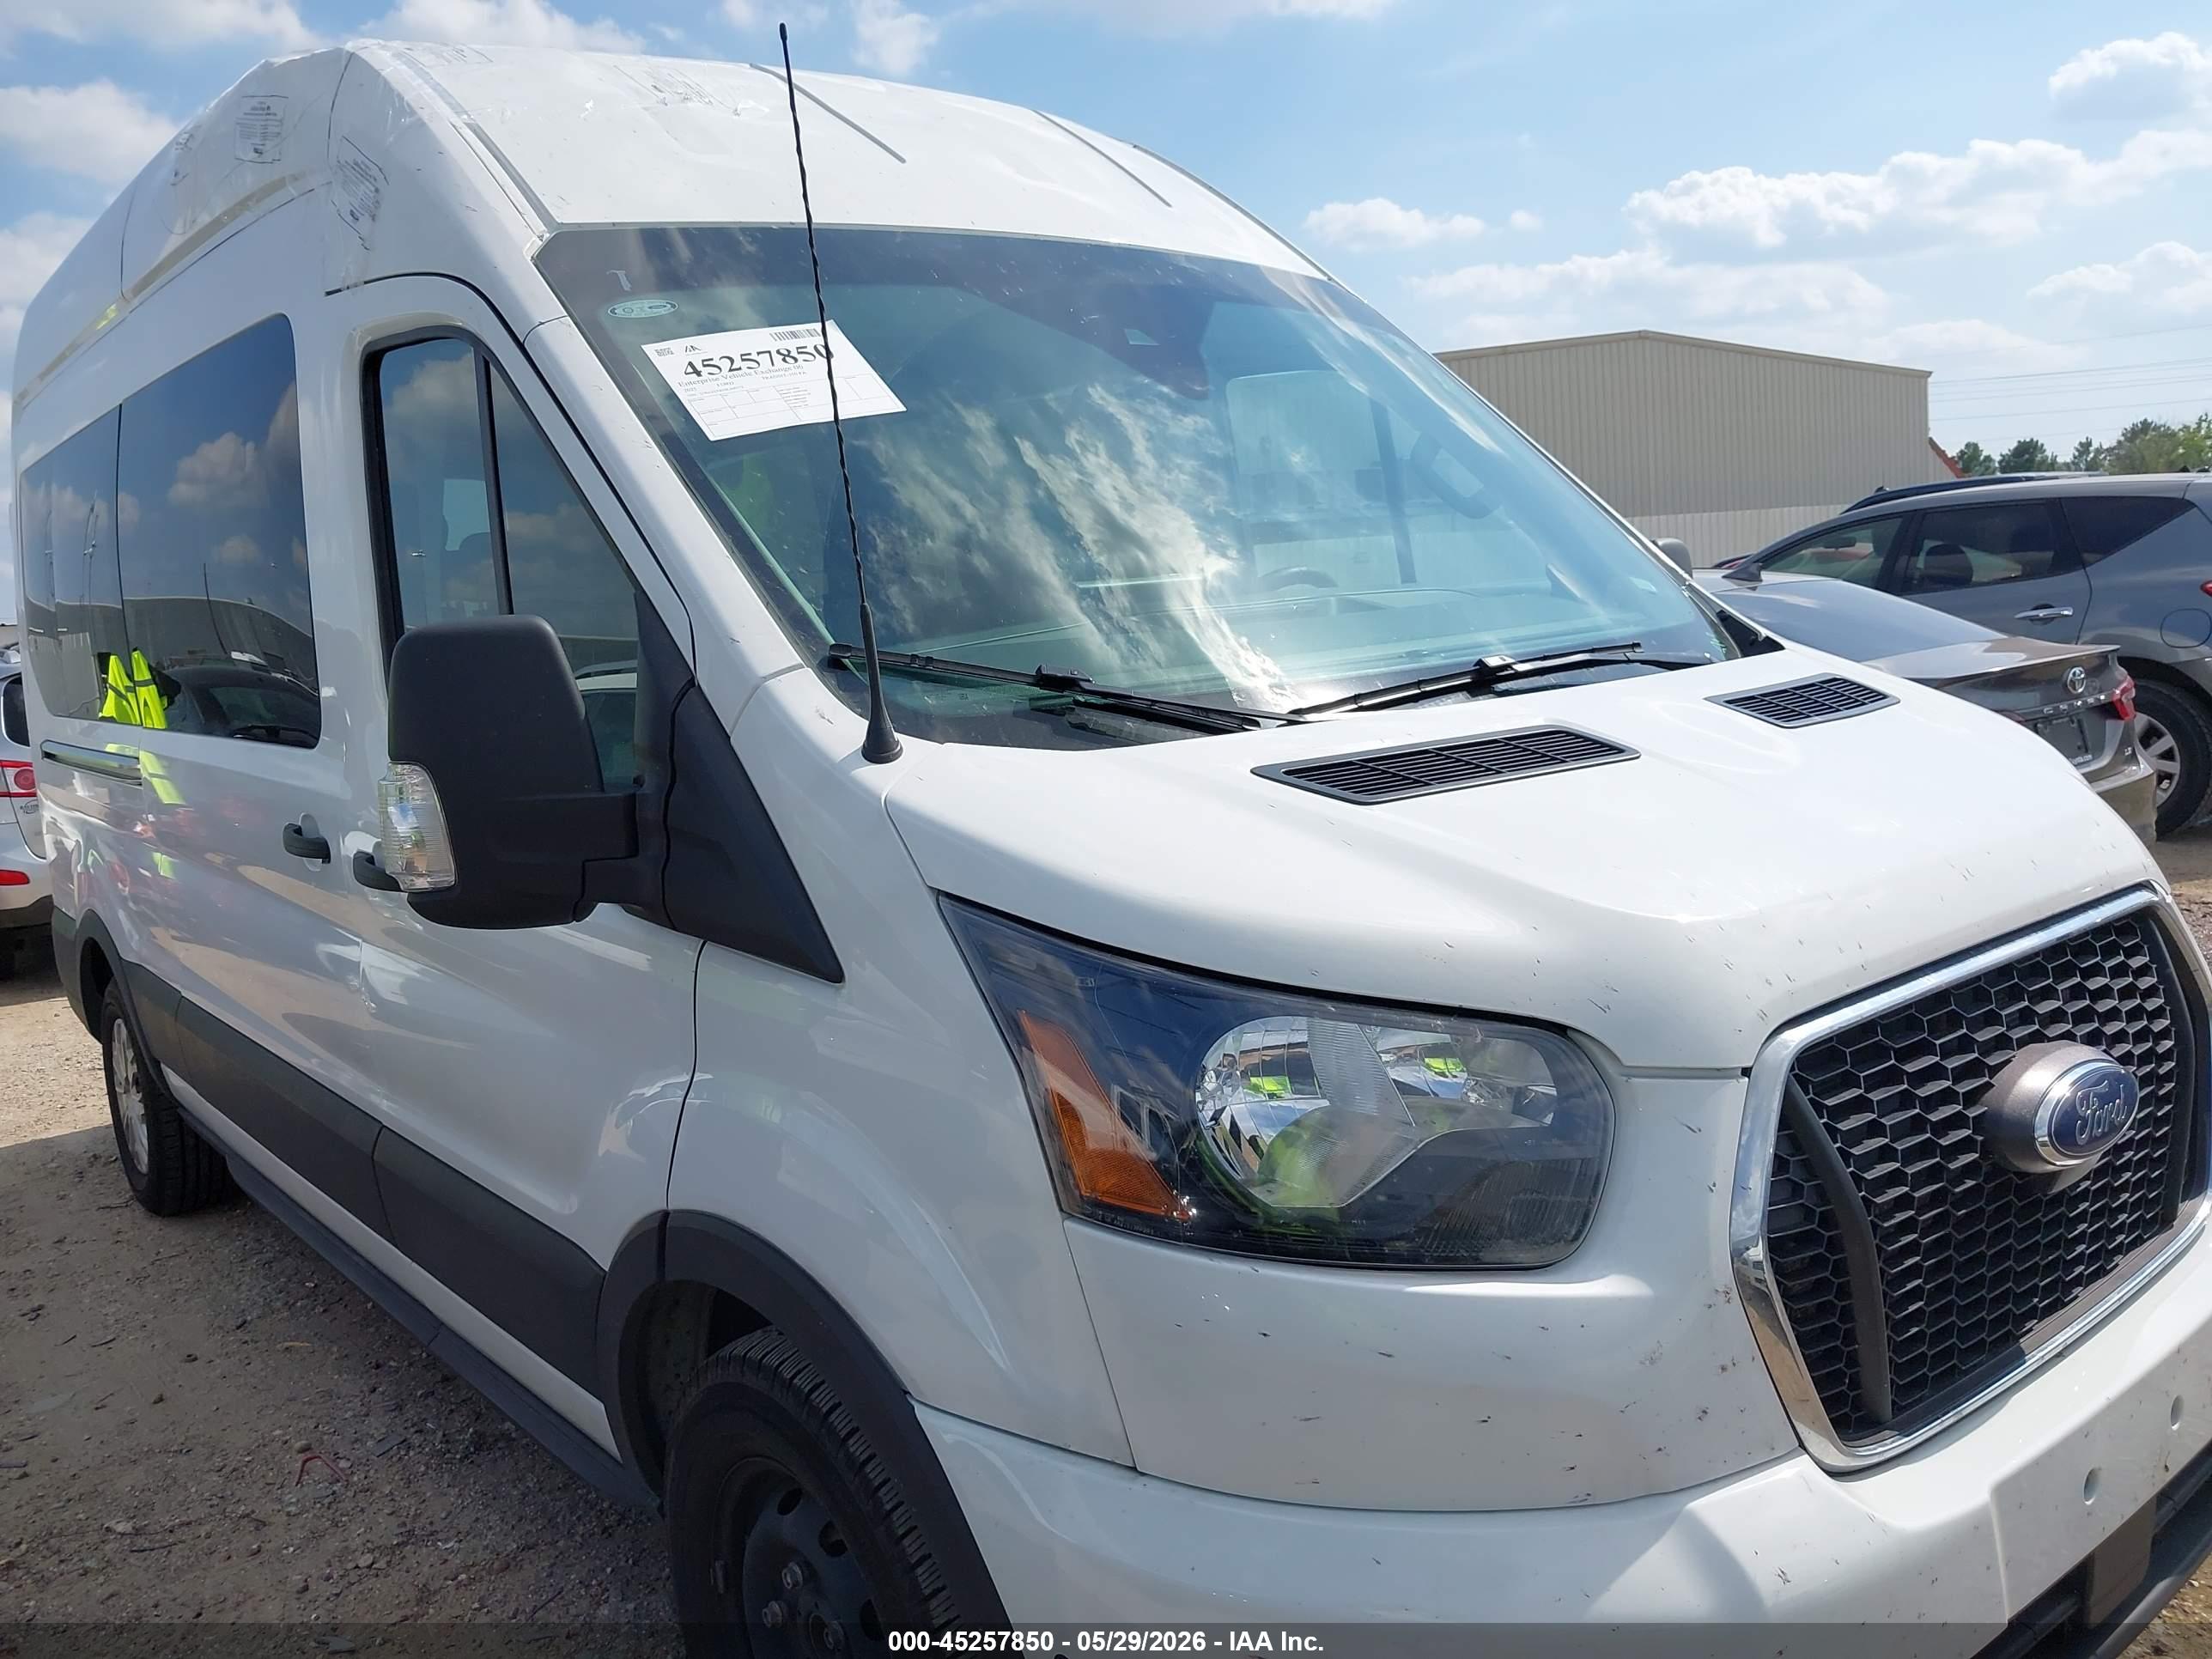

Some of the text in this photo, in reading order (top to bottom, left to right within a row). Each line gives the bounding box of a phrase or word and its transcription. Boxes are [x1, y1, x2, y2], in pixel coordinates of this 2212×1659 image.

[678, 376, 720, 387] Enterprise
[721, 369, 753, 380] Vehicle
[754, 366, 792, 375] Exchange
[684, 343, 834, 377] 45257850
[2075, 1079, 2128, 1146] Ford
